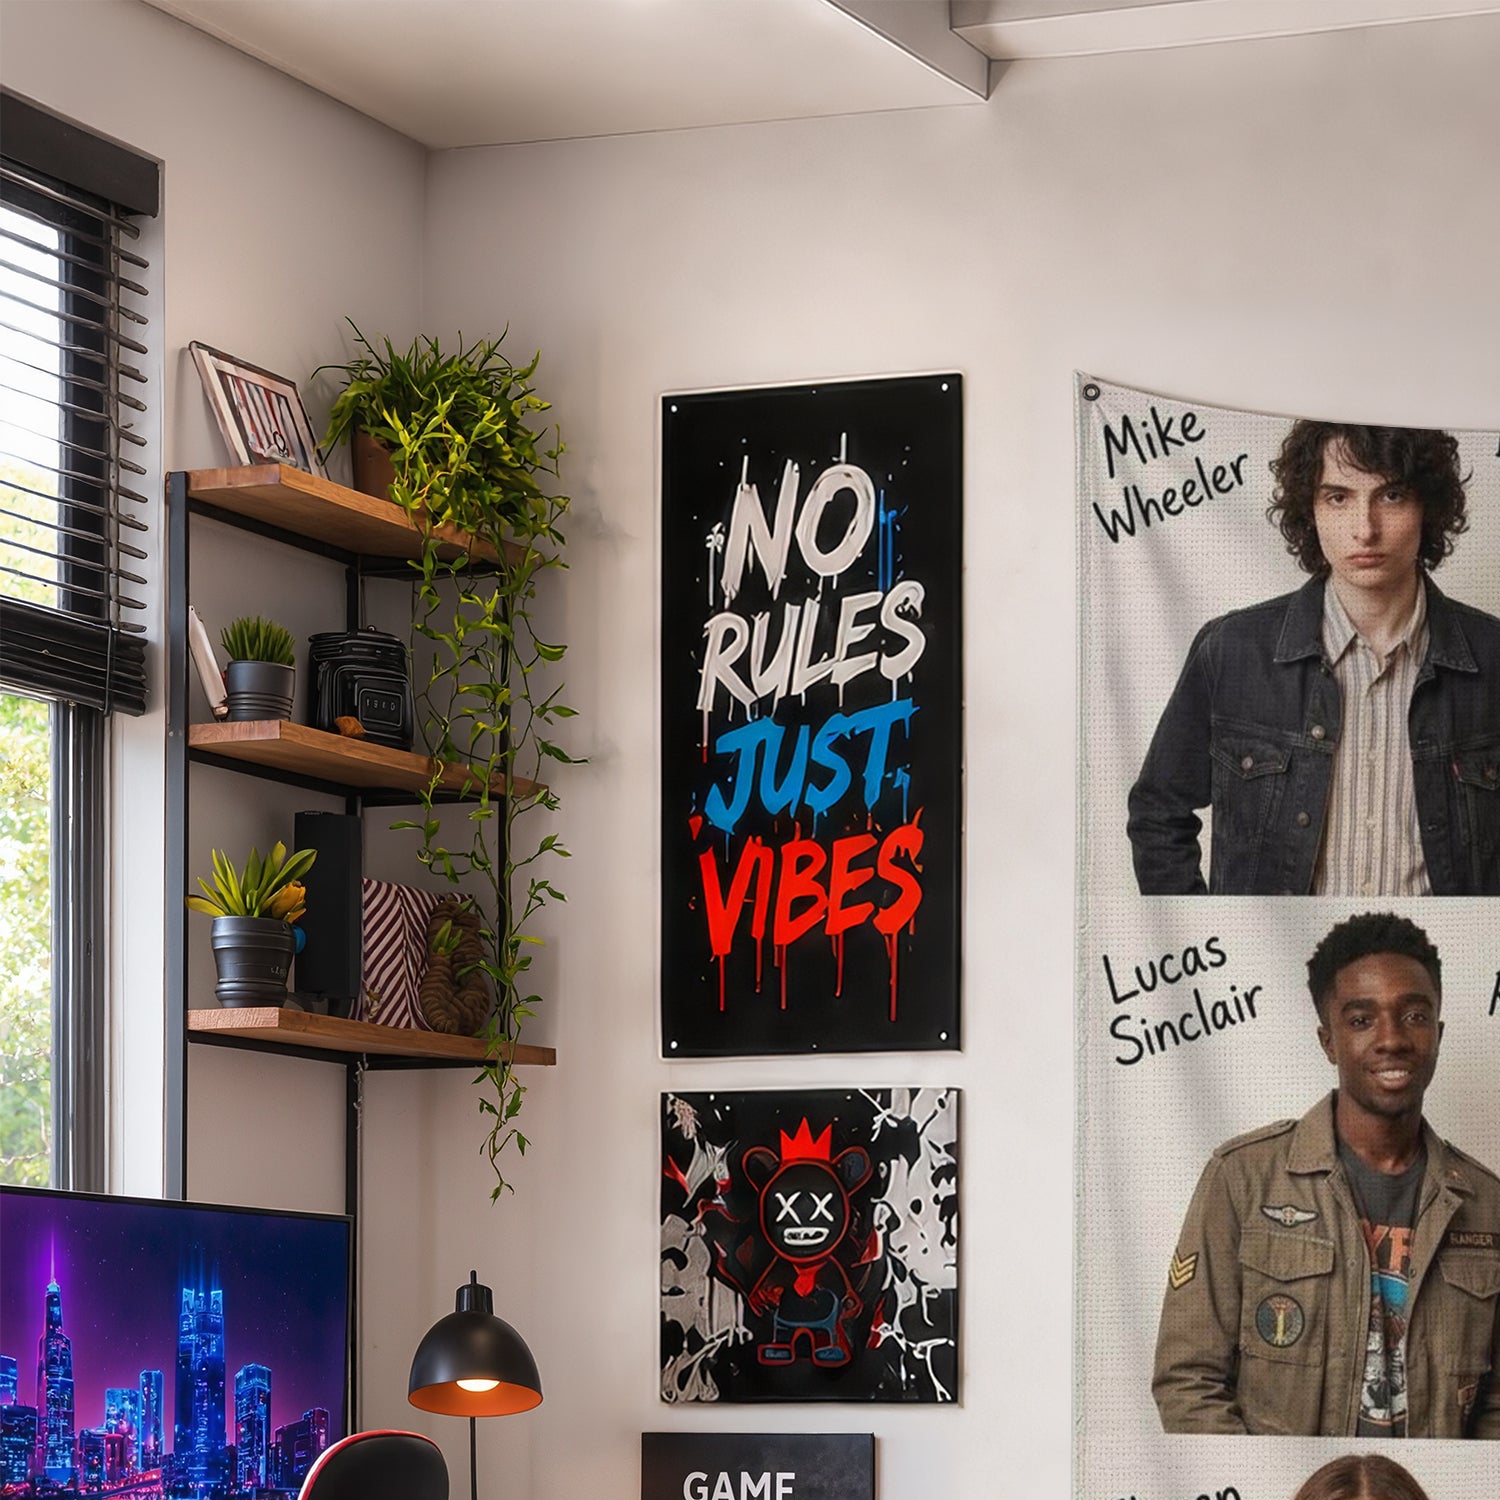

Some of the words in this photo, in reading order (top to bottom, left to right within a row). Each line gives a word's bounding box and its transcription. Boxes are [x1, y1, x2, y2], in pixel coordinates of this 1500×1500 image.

[1092, 453, 1249, 543] Wheeler
[1103, 406, 1206, 479] Mike
[720, 455, 877, 601] NO
[697, 580, 926, 713] RULES
[704, 697, 921, 836] JUST
[698, 812, 924, 962] VIBES
[1103, 936, 1228, 1004] Lucas
[1110, 985, 1263, 1066] Sinclair
